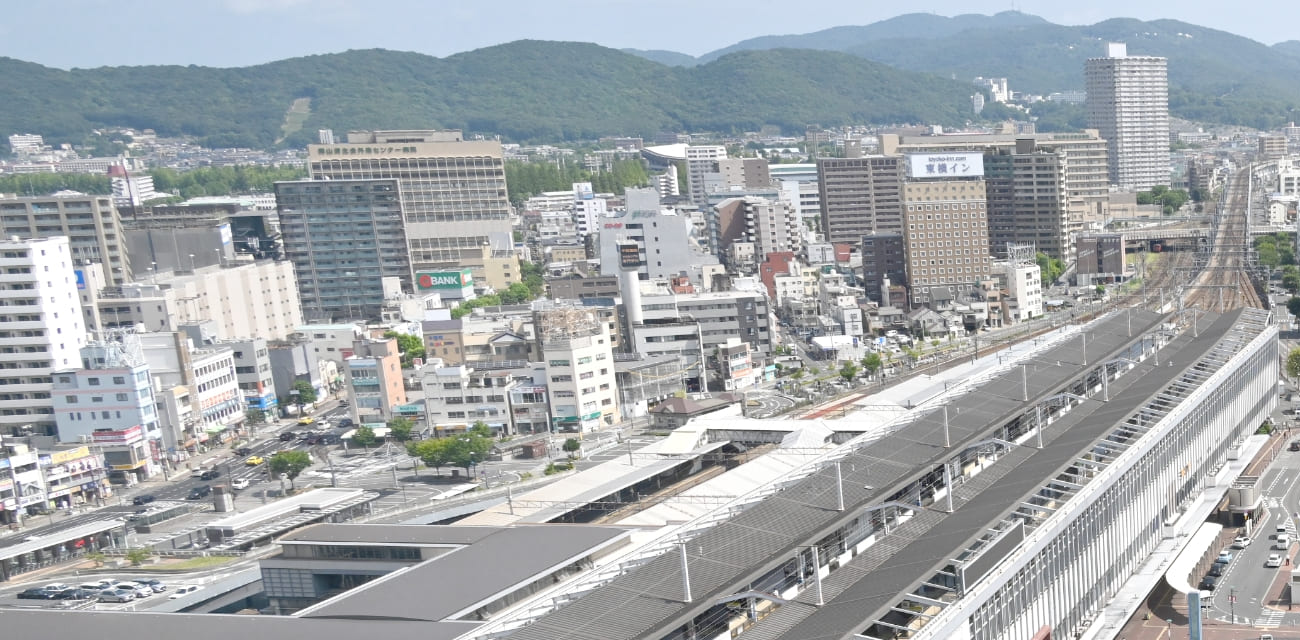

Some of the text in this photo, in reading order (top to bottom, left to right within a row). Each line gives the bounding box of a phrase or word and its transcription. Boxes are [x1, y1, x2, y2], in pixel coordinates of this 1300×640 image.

[926, 163, 970, 174] 東横イン
[431, 276, 459, 286] BANK
